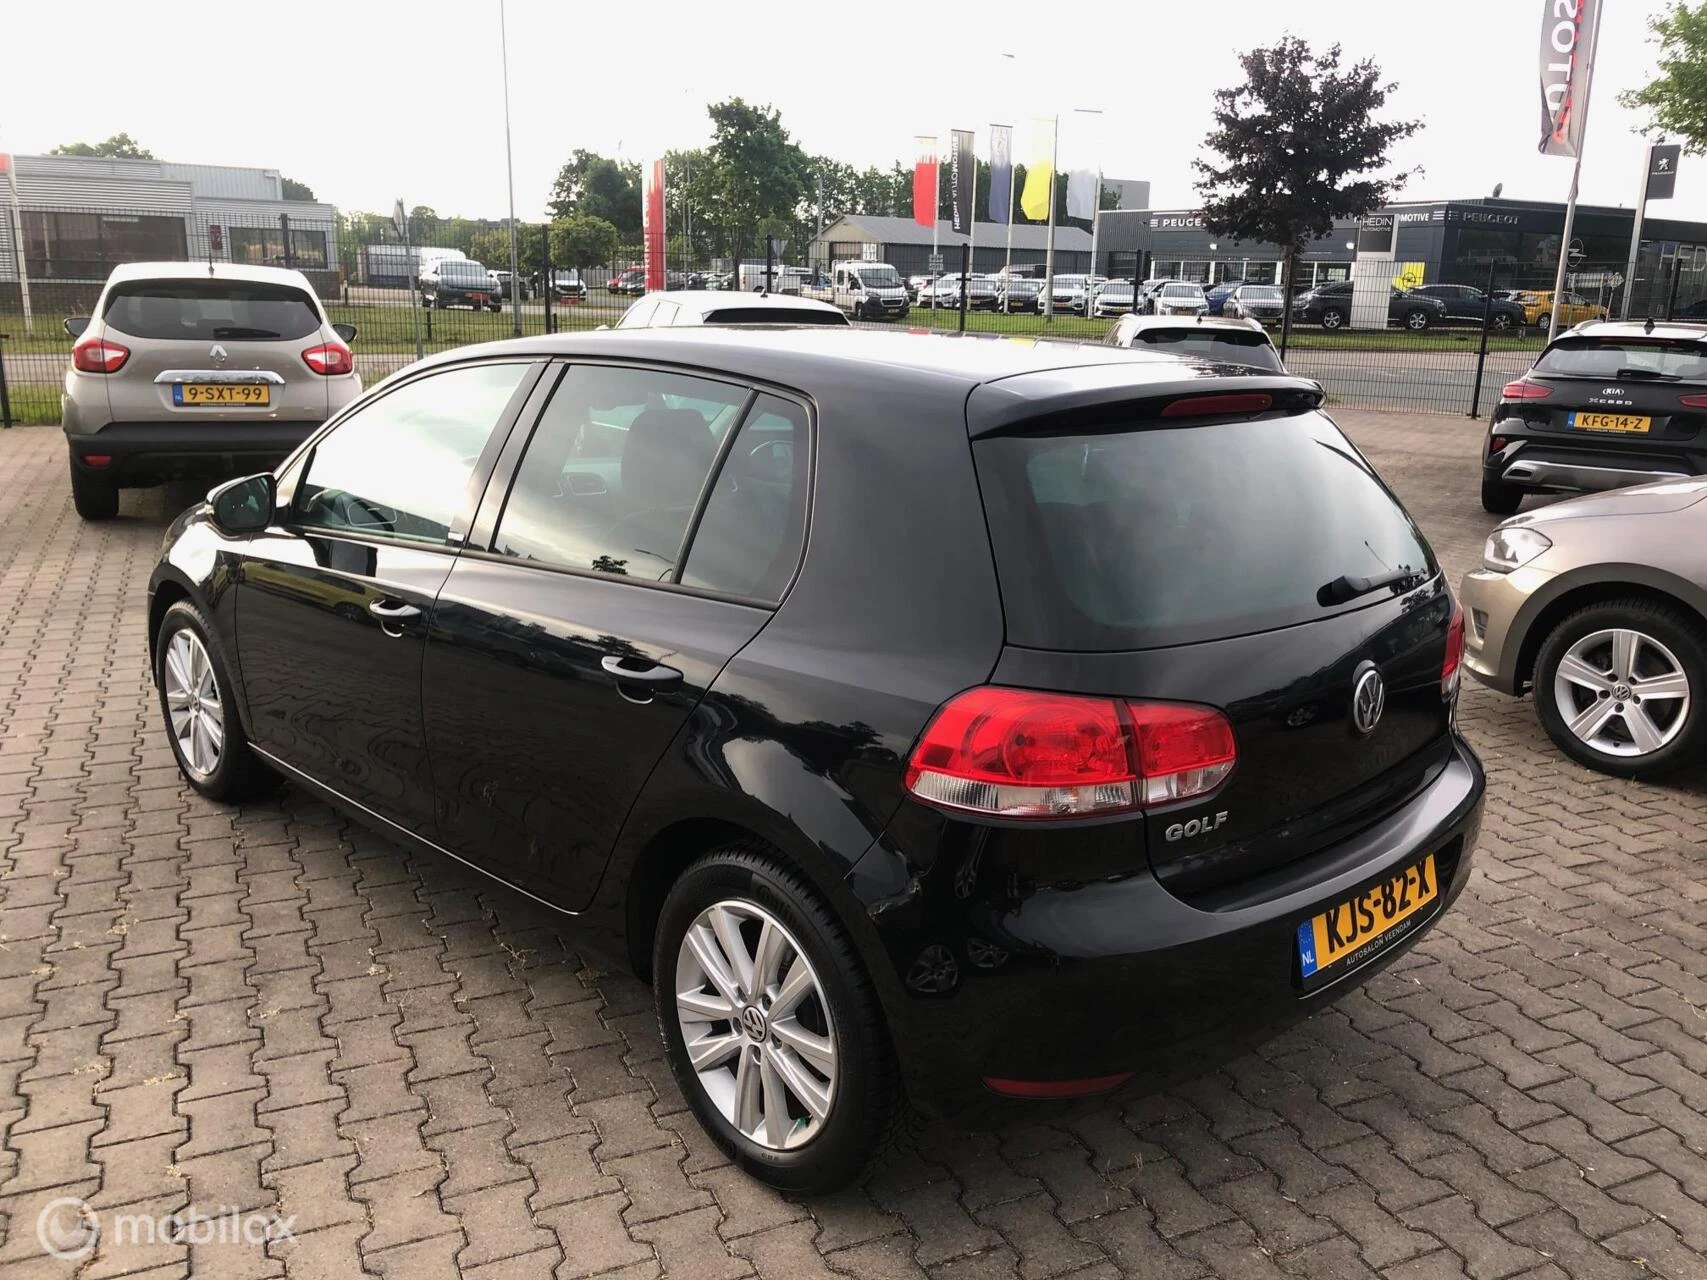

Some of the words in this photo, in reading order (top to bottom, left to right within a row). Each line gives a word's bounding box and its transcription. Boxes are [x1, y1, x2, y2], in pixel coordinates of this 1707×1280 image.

[1162, 218, 1207, 228] PEUGE
[1362, 217, 1393, 226] HEDIN
[1400, 212, 1430, 222] MOTIVE
[1463, 211, 1520, 225] PEUGEOT
[188, 387, 262, 401] 9-SXT-99
[1581, 414, 1643, 430] KFG-14-Z
[1165, 811, 1229, 842] GOLF
[1325, 860, 1430, 954] KJS-82-X
[1346, 935, 1384, 966] AUTOSALON
[1384, 919, 1412, 943] VEENDAM
[1302, 950, 1315, 967] NL
